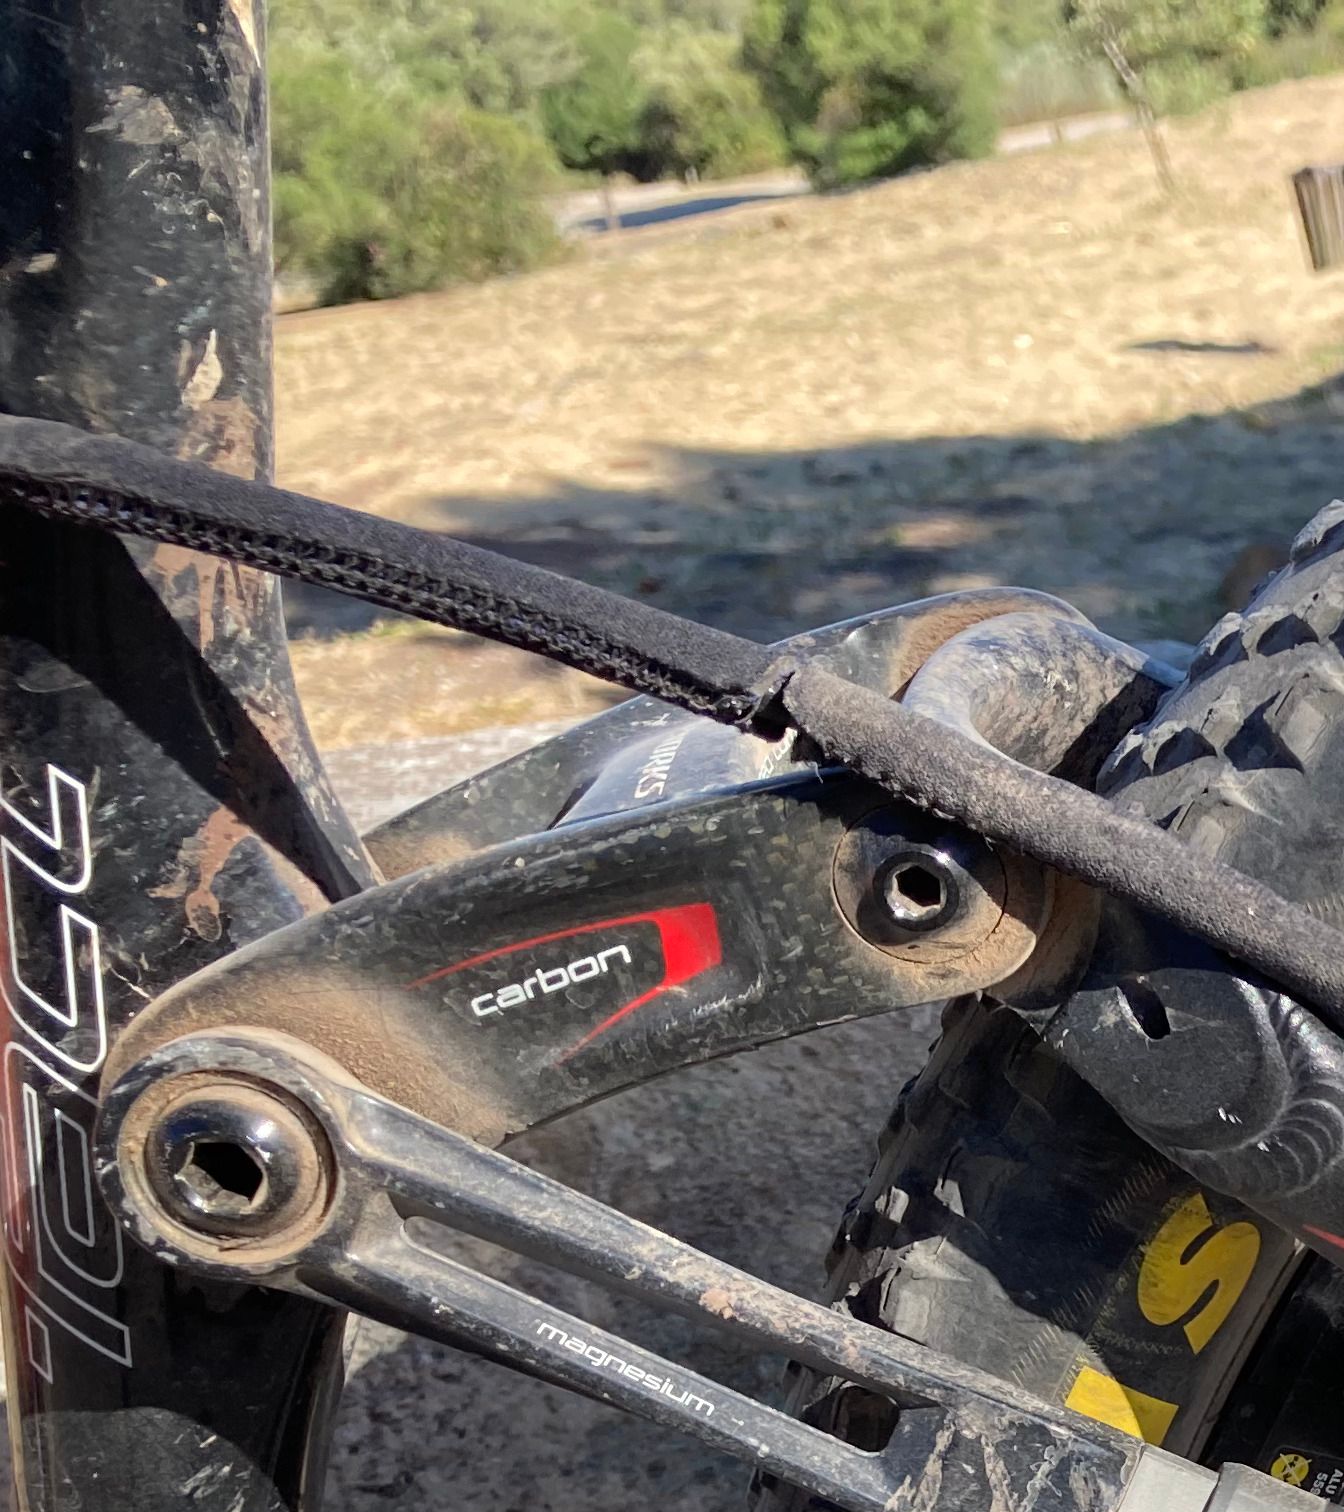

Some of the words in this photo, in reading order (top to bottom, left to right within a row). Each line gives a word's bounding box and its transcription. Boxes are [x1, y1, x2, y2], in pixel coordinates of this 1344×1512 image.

[471, 941, 633, 1018] carbon
[535, 1319, 716, 1418] magnesium
[1325, 1468, 1344, 1494] ALU
